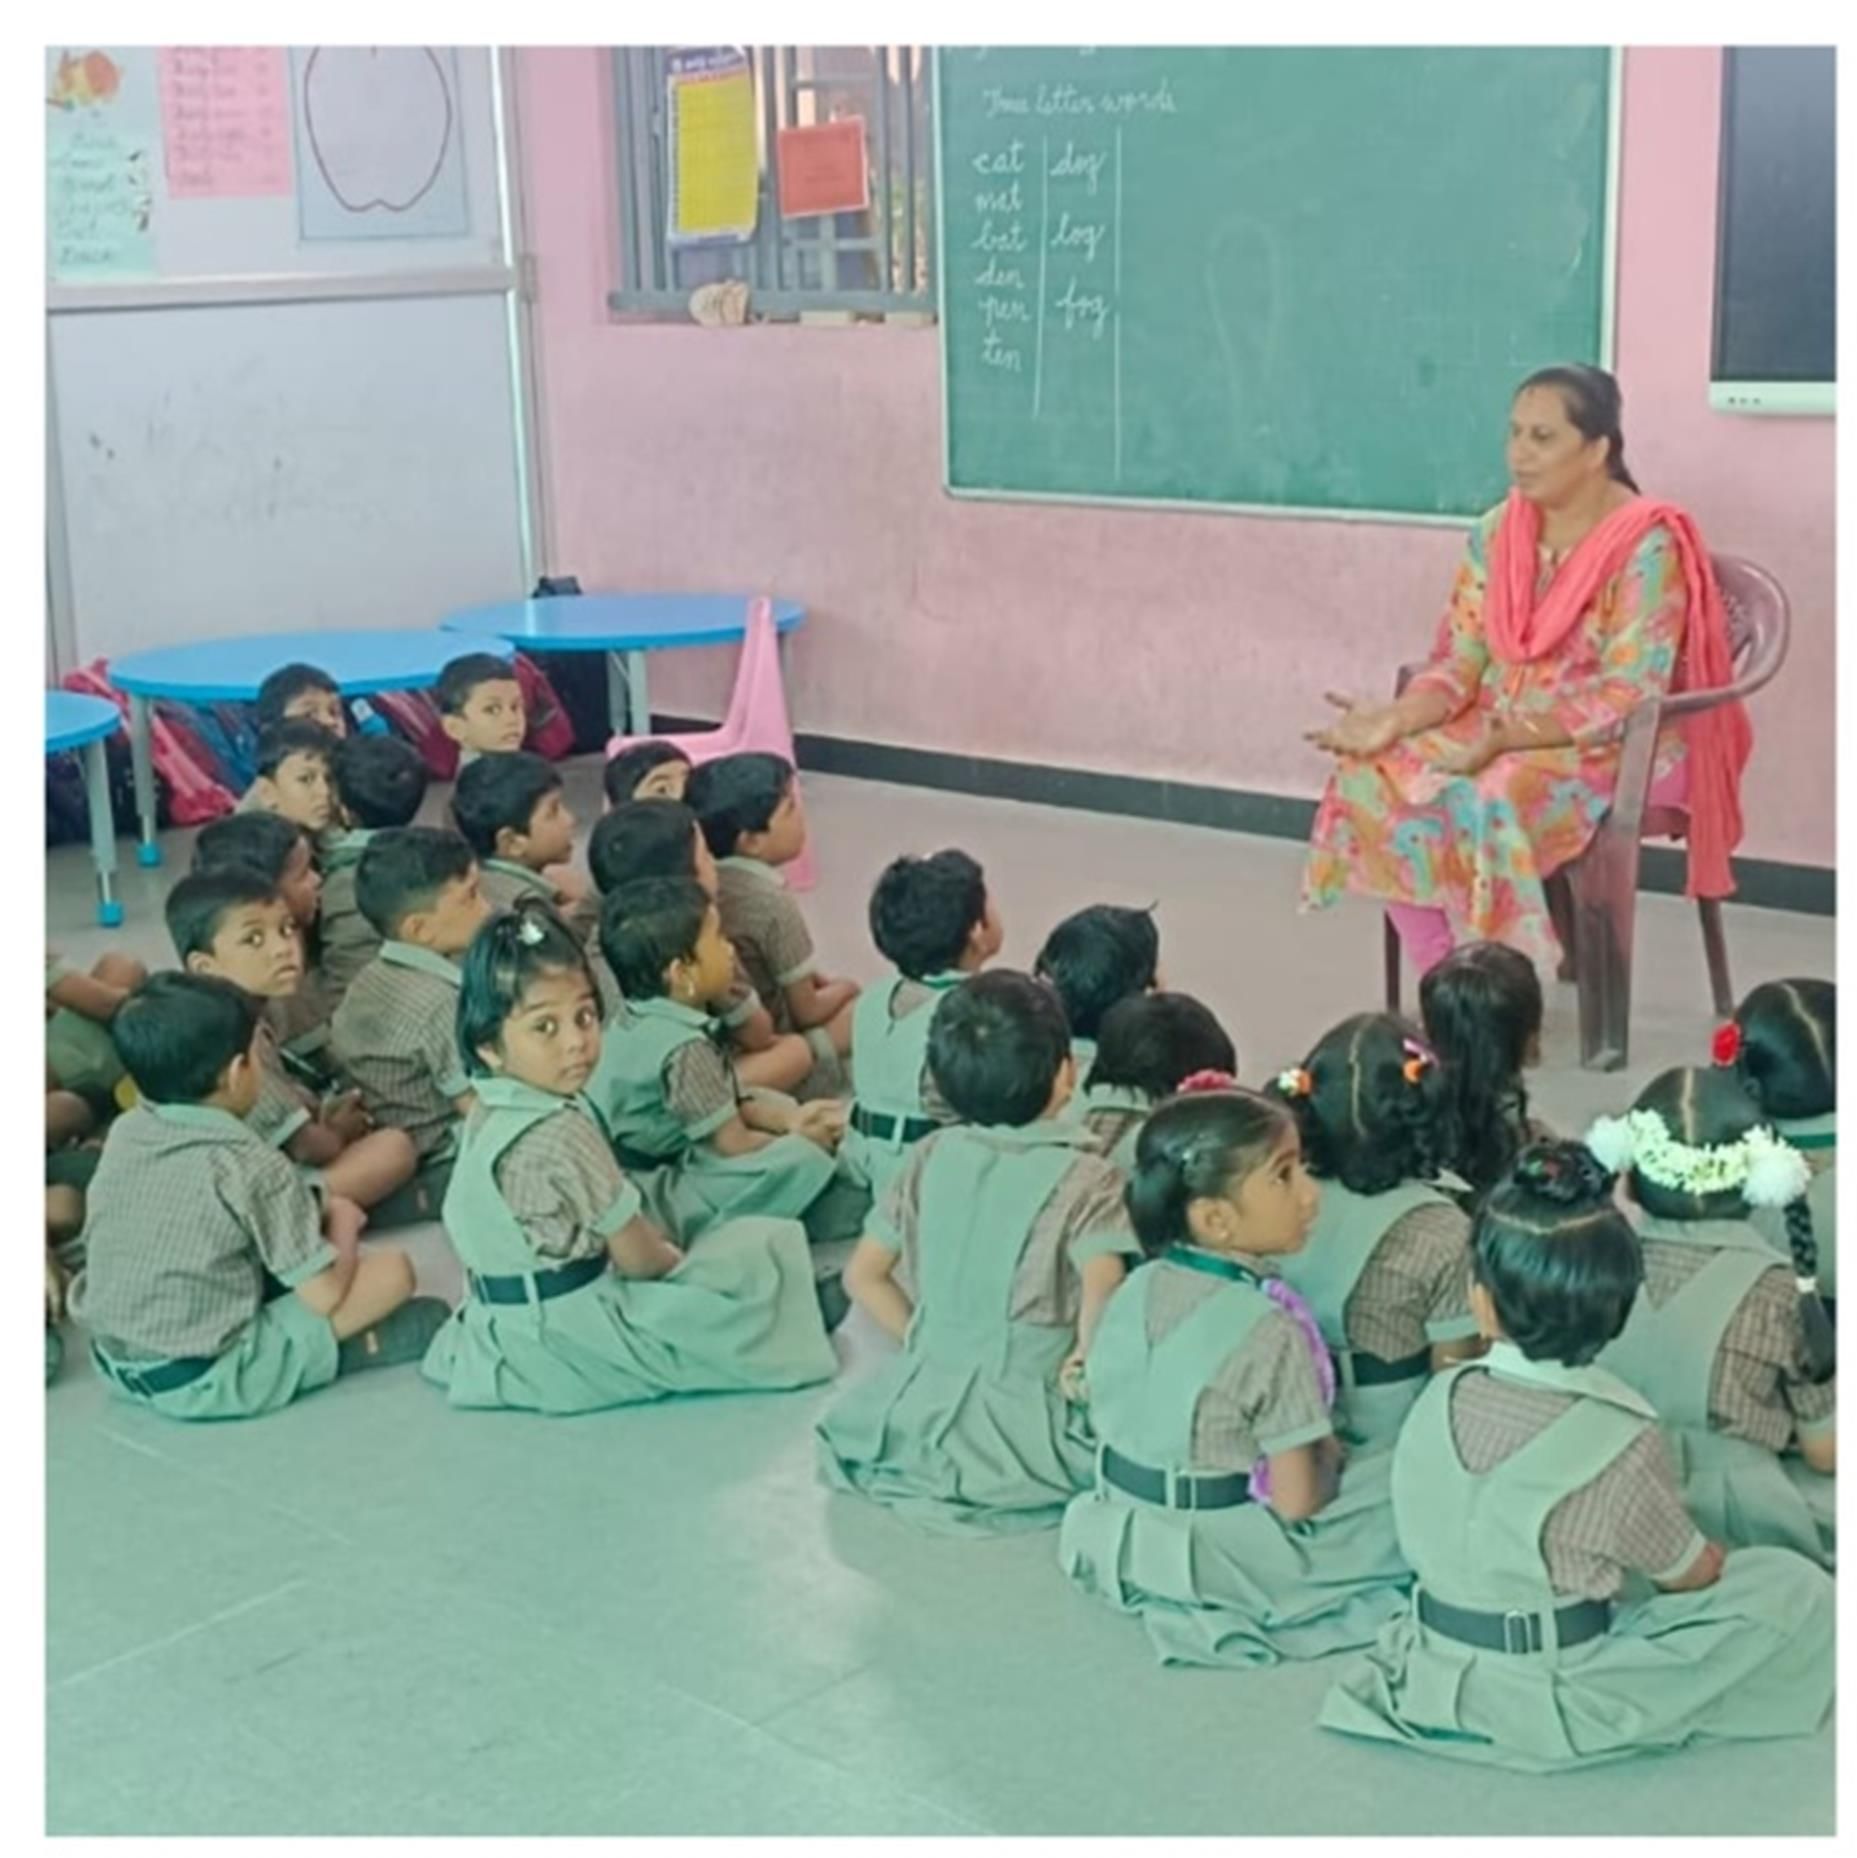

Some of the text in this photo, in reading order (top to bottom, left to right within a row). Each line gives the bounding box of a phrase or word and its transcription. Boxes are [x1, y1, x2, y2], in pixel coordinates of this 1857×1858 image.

[971, 137, 1026, 175] cat
[1049, 139, 1108, 197] dog
[1050, 210, 1105, 263] log
[977, 295, 1032, 327] pen
[1054, 273, 1110, 341] fog
[981, 326, 1021, 372] ten
